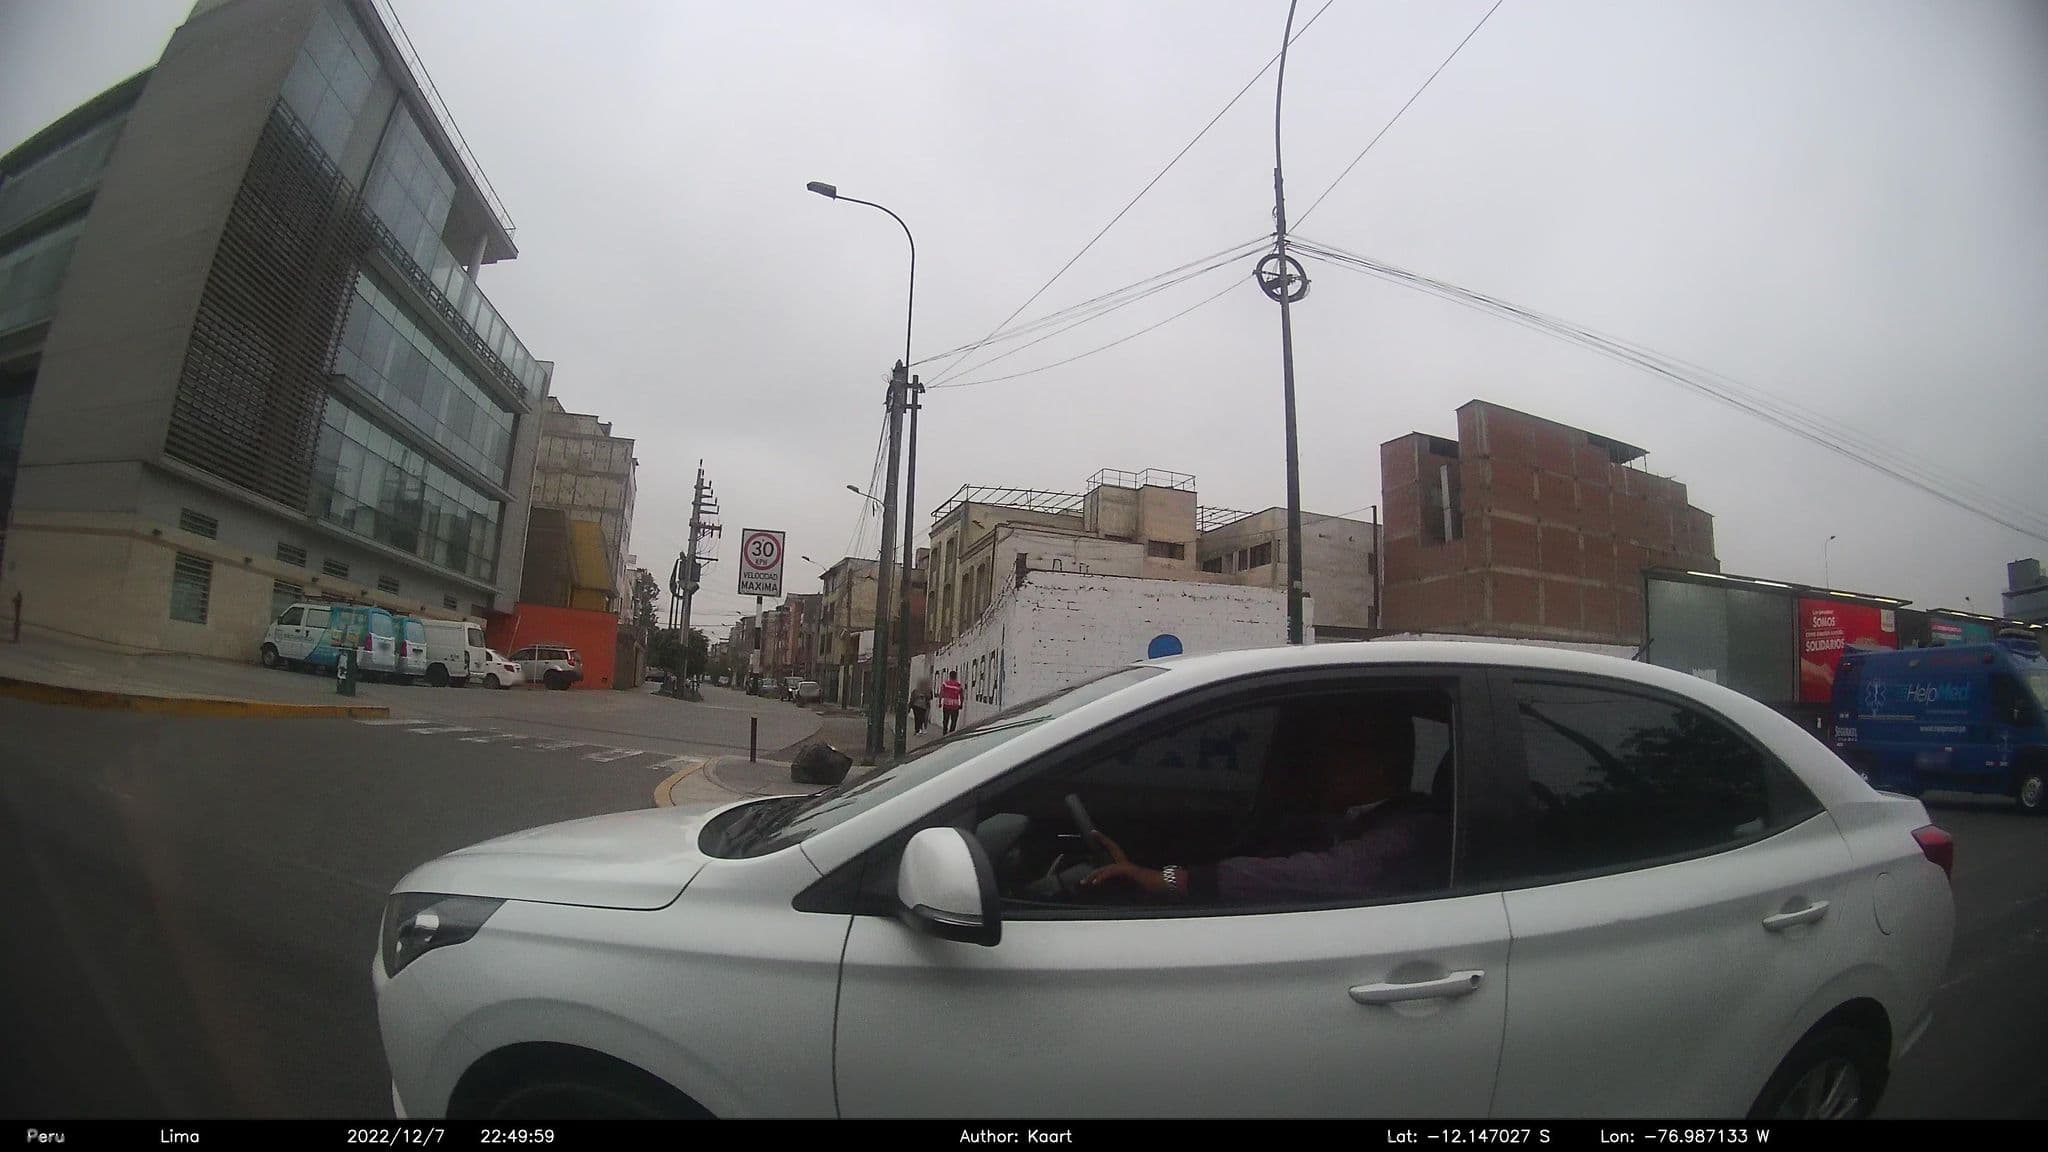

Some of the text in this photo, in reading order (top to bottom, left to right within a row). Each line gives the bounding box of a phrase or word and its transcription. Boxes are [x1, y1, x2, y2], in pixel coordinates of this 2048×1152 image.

[752, 541, 774, 557] 30
[744, 572, 778, 580] VELOCIDAD
[741, 581, 777, 592] MAXIMA
[1805, 637, 1845, 652] SOLIDARIOS
